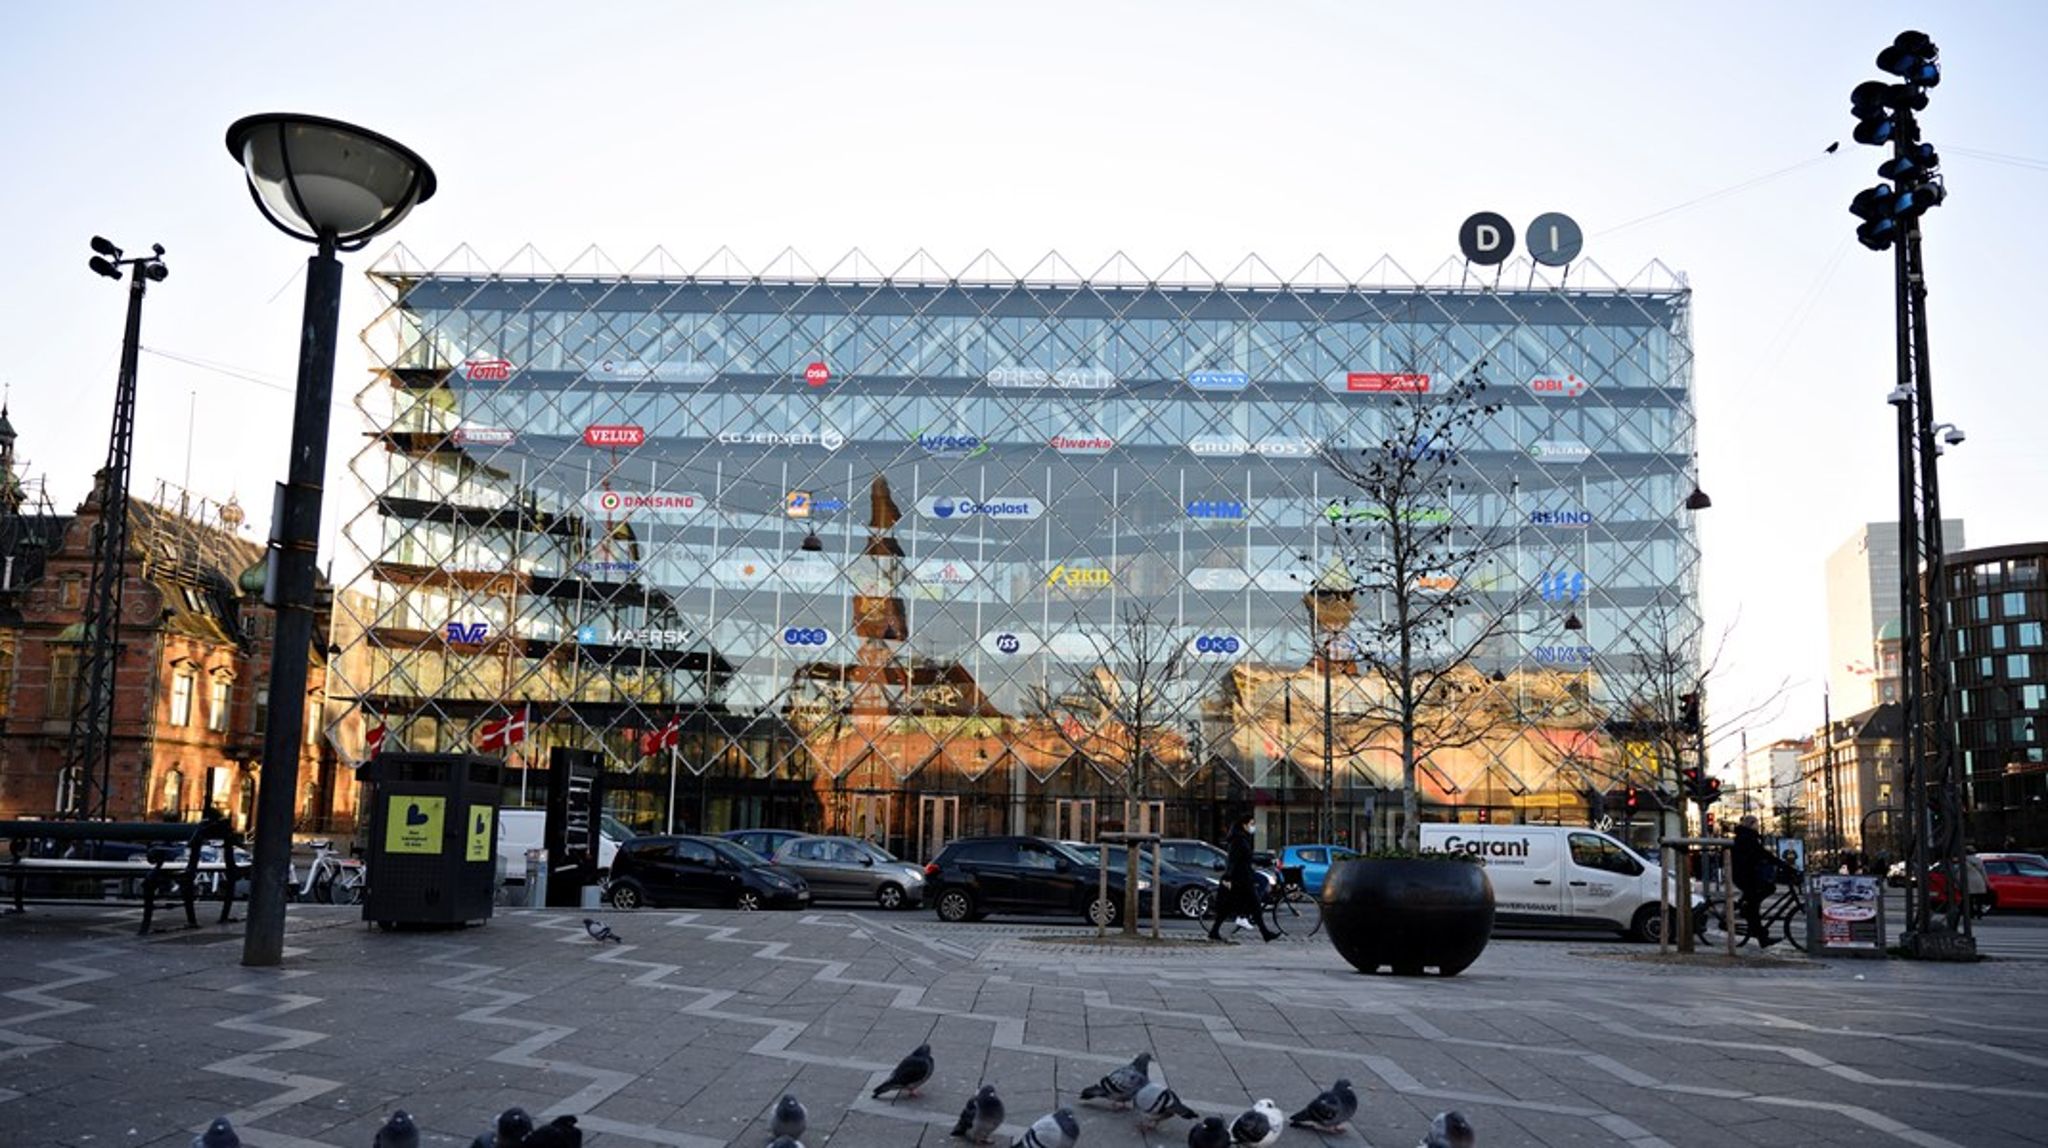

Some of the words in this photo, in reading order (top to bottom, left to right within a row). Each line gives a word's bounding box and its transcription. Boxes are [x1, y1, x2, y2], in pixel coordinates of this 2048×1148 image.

[1476, 224, 1500, 251] D
[464, 361, 512, 380] Toms
[1532, 379, 1563, 392] DBI
[590, 429, 638, 443] VELUX
[919, 432, 979, 451] Lyreco
[623, 495, 694, 509] DANSAND
[959, 501, 1029, 517] Coloplast
[446, 622, 488, 644] AVK
[604, 629, 691, 644] MAERSK
[785, 630, 827, 644] JKS
[1198, 637, 1239, 651] JKS
[1444, 835, 1530, 856] Garant
